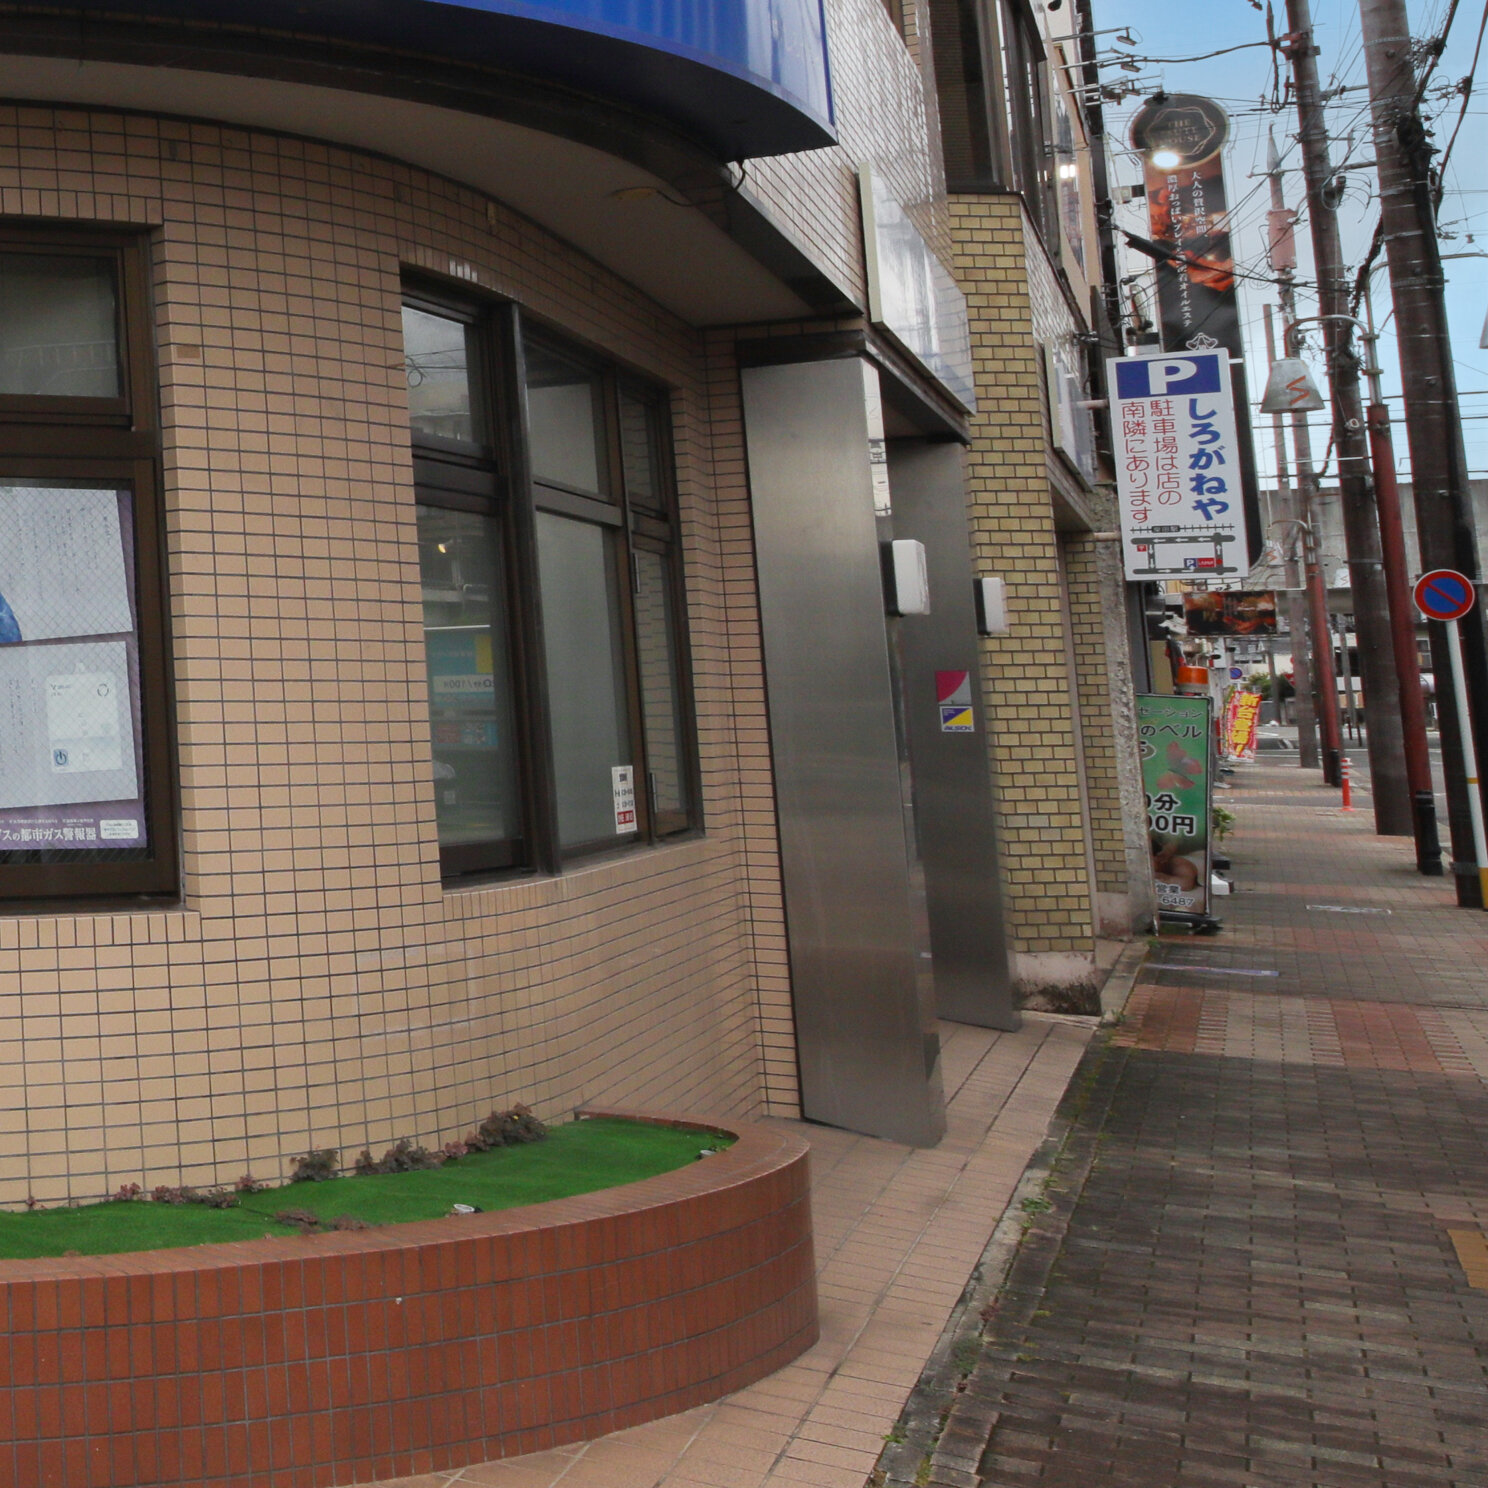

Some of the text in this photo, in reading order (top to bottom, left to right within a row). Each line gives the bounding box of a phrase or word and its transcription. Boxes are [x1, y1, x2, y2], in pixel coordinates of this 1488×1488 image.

[1147, 360, 1197, 395] P
[1121, 401, 1152, 524] 南隣にあります
[1150, 399, 1182, 506] 駐車場は店の
[1188, 398, 1229, 521] しろがねや
